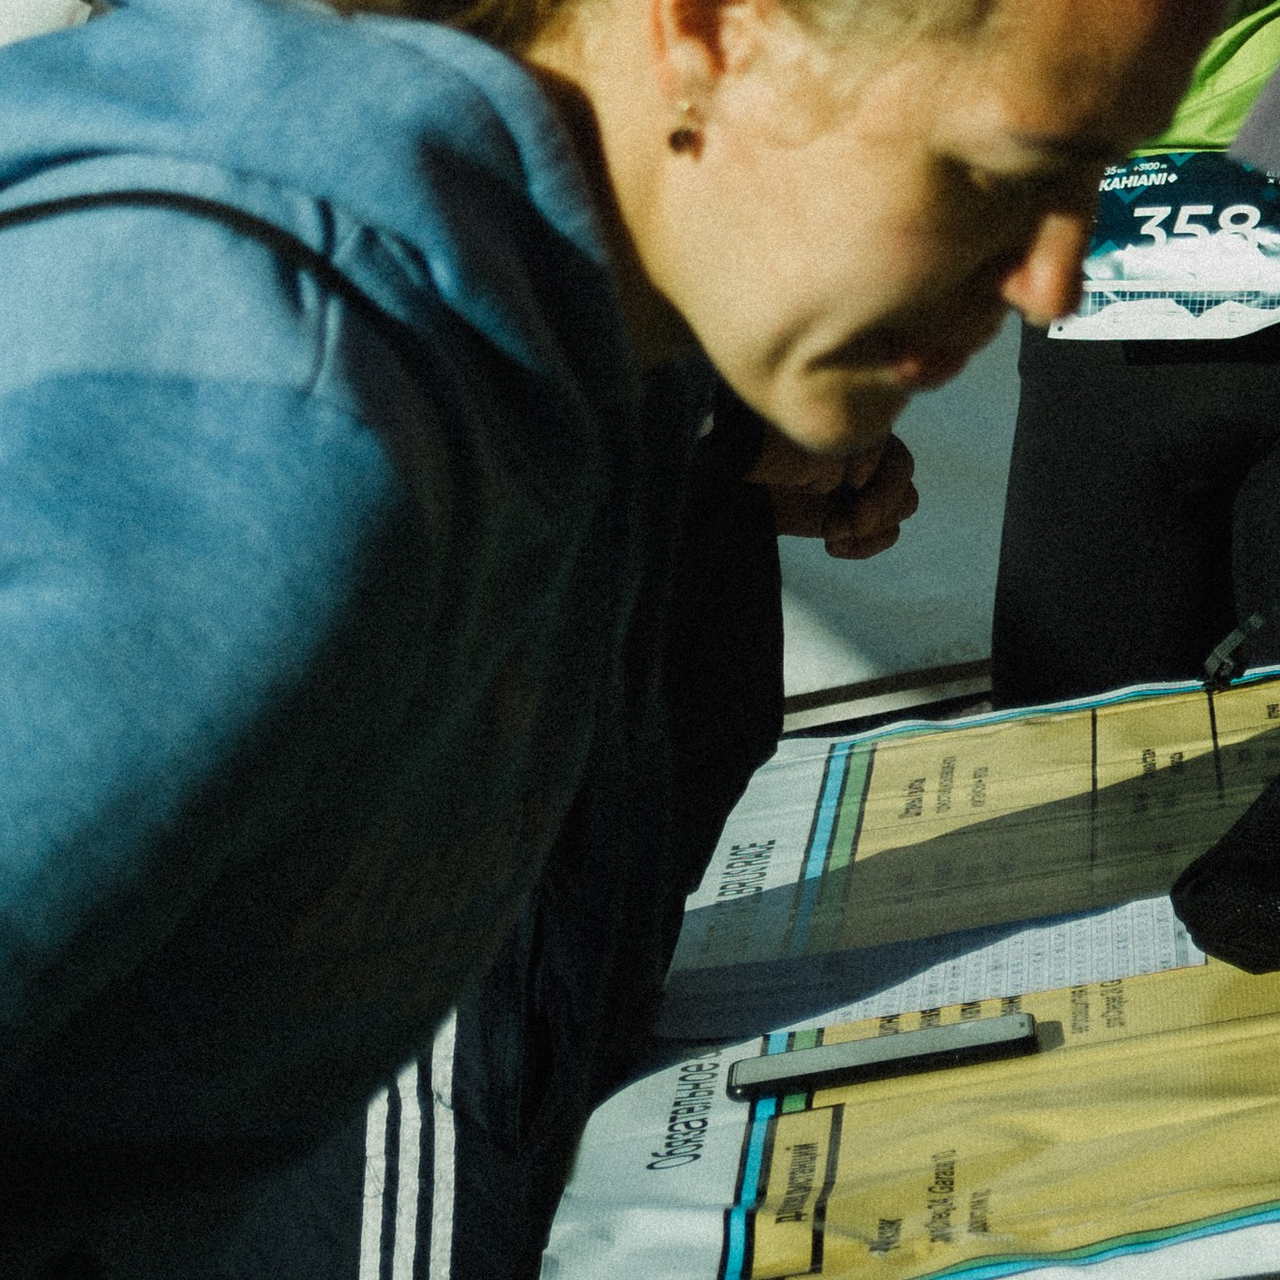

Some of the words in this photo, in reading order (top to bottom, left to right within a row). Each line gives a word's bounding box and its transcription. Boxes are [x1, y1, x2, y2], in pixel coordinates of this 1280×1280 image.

[1098, 172, 1168, 192] KAHIANI
[1131, 203, 1262, 250] 358
[645, 1062, 720, 1171] Обязательное
